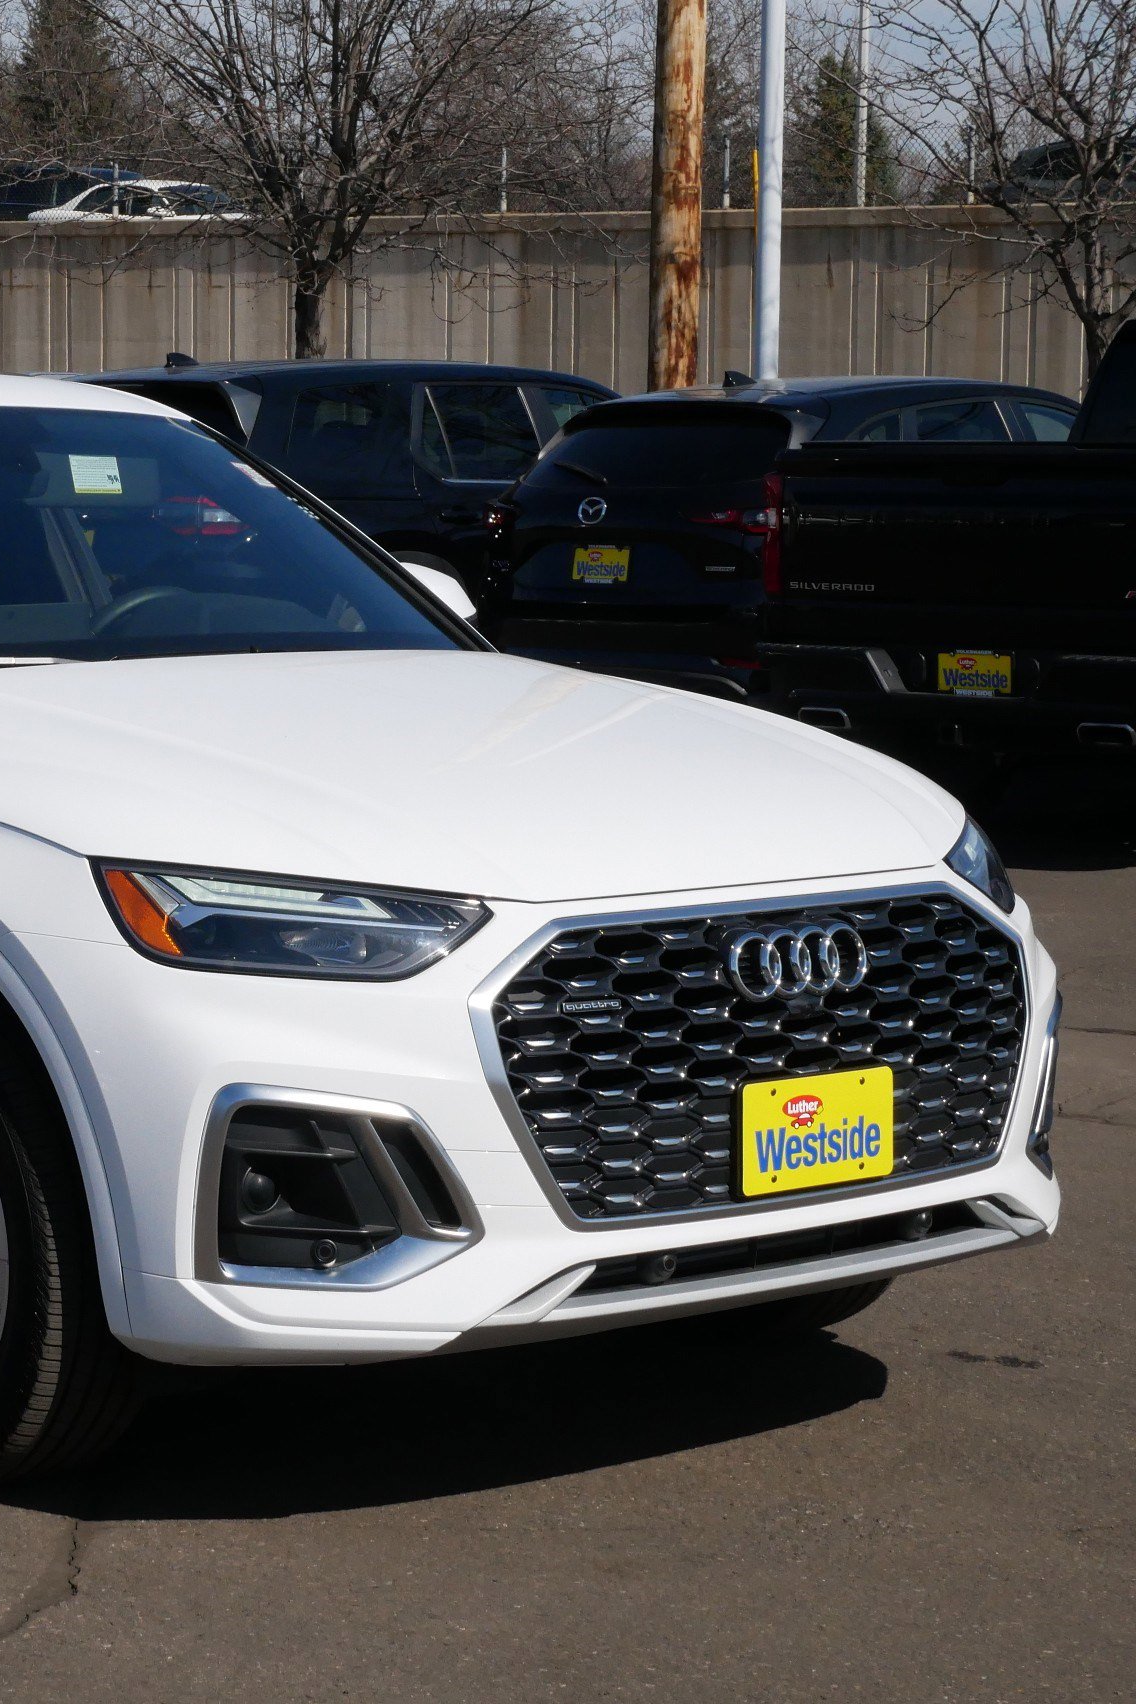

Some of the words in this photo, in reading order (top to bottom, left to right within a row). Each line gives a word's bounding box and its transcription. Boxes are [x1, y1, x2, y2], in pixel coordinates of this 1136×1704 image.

[577, 561, 625, 577] Westside
[789, 581, 875, 592] SILVERADO
[942, 668, 1008, 688] Westside
[566, 1001, 620, 1011] quattro
[787, 1100, 819, 1115] Luther
[754, 1115, 881, 1174] Westside
